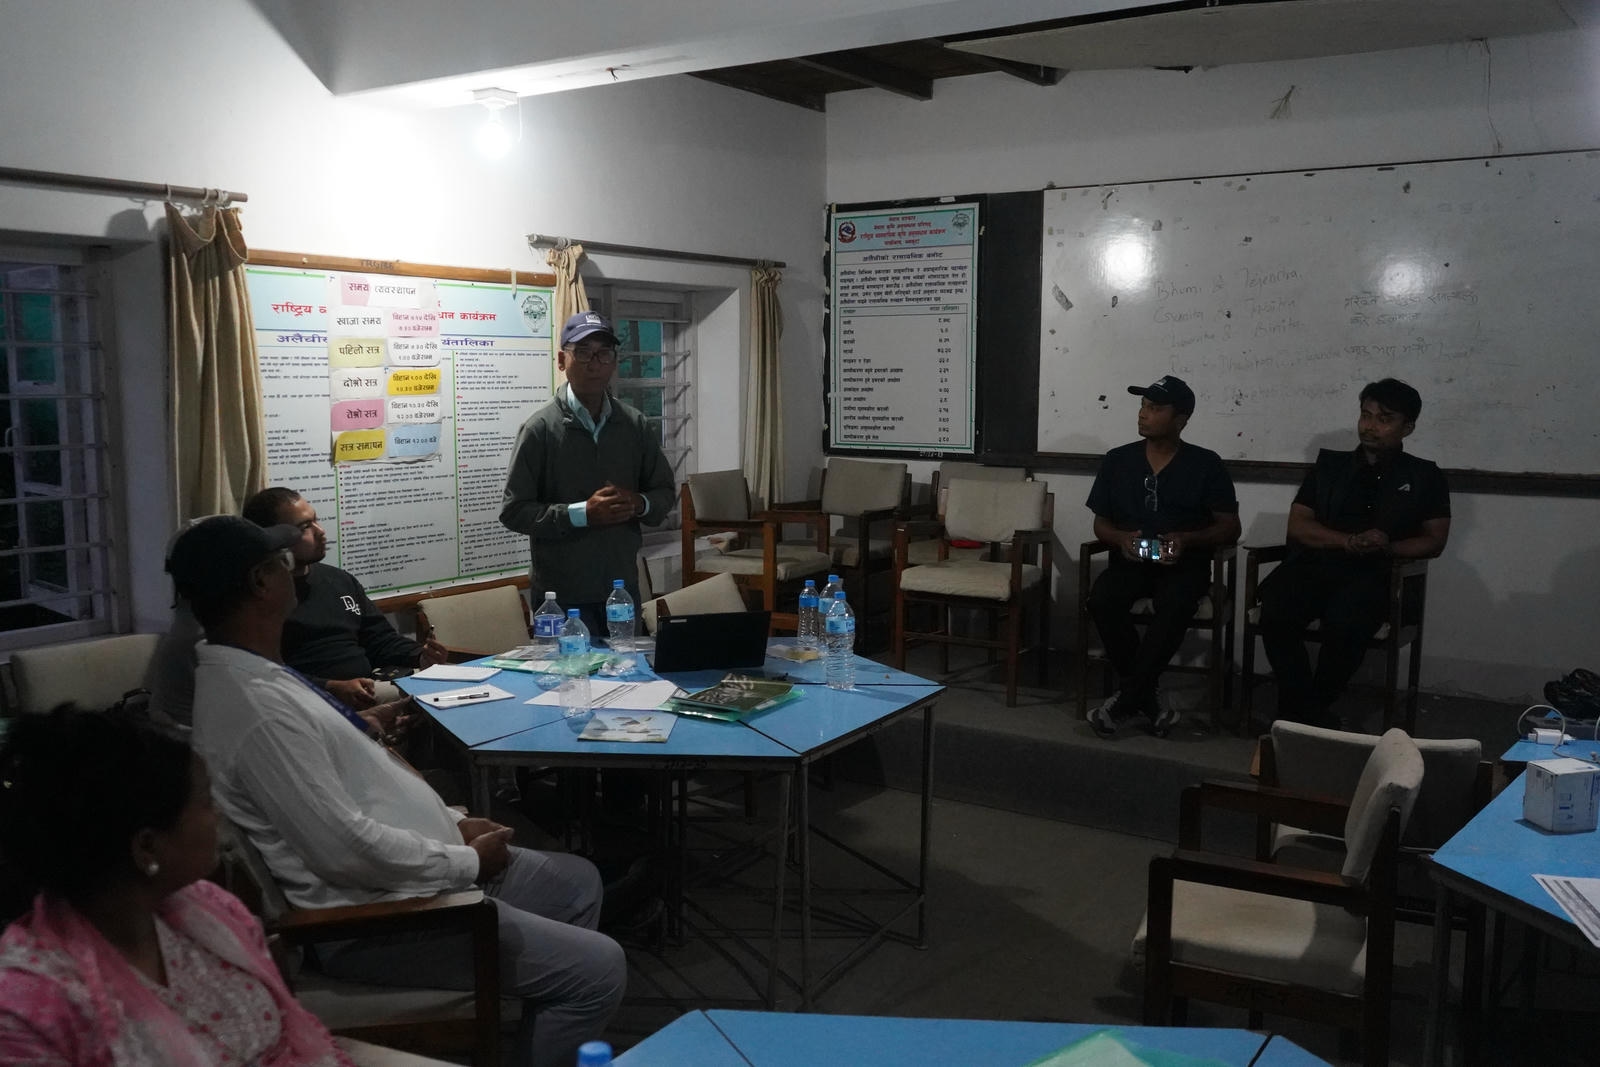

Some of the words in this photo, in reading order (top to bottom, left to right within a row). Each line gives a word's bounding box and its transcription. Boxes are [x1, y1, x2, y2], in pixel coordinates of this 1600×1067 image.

[271, 302, 313, 317] राष्ट्रिय
[336, 317, 359, 326] खाजा
[338, 344, 364, 355] पहिलो
